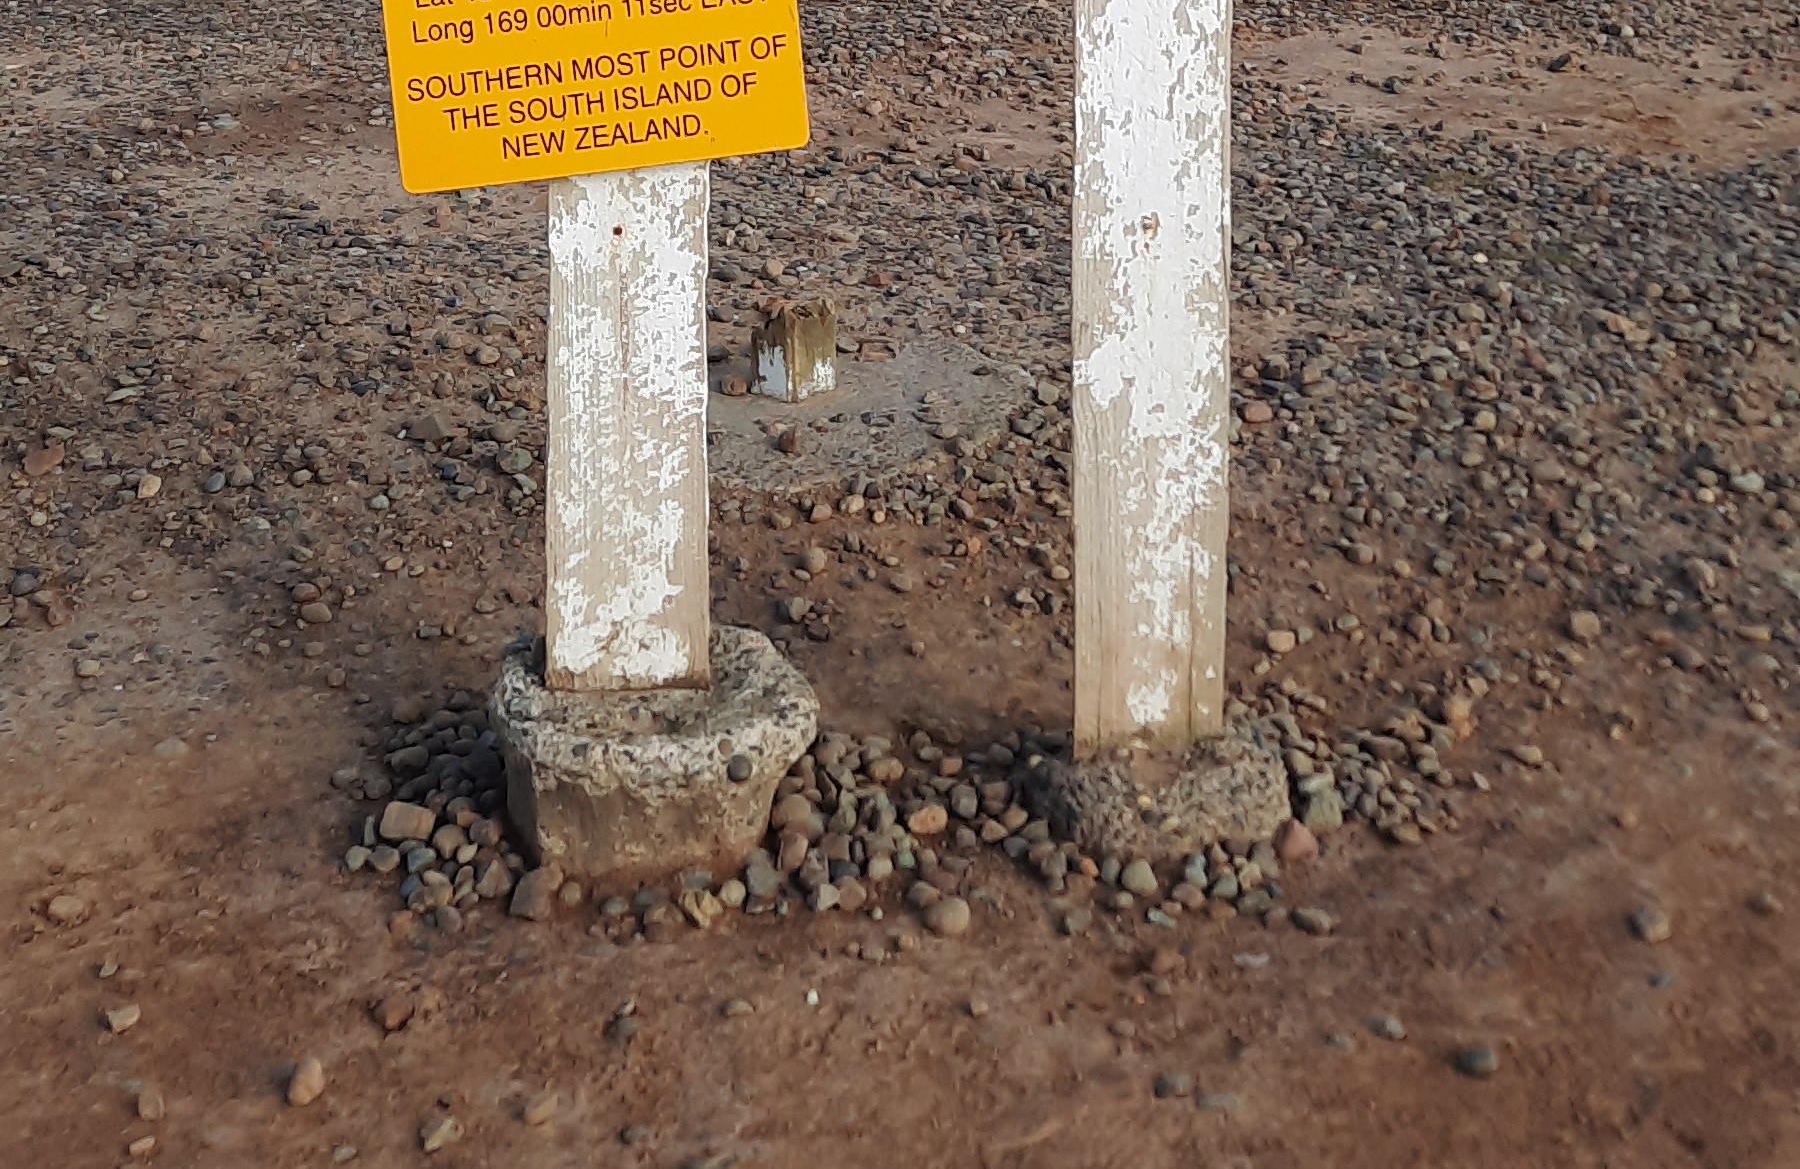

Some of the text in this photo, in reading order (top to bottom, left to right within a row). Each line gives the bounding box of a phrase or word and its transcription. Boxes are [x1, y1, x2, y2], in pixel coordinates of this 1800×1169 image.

[412, 20, 474, 44] Long
[484, 8, 528, 34] 169
[536, 0, 612, 28] 00min
[407, 34, 788, 102] SOUTHERN MOST POINT OF
[443, 72, 758, 131] THE SOUTH ISLAND OF
[502, 114, 710, 160] NEW ZEALAND.
